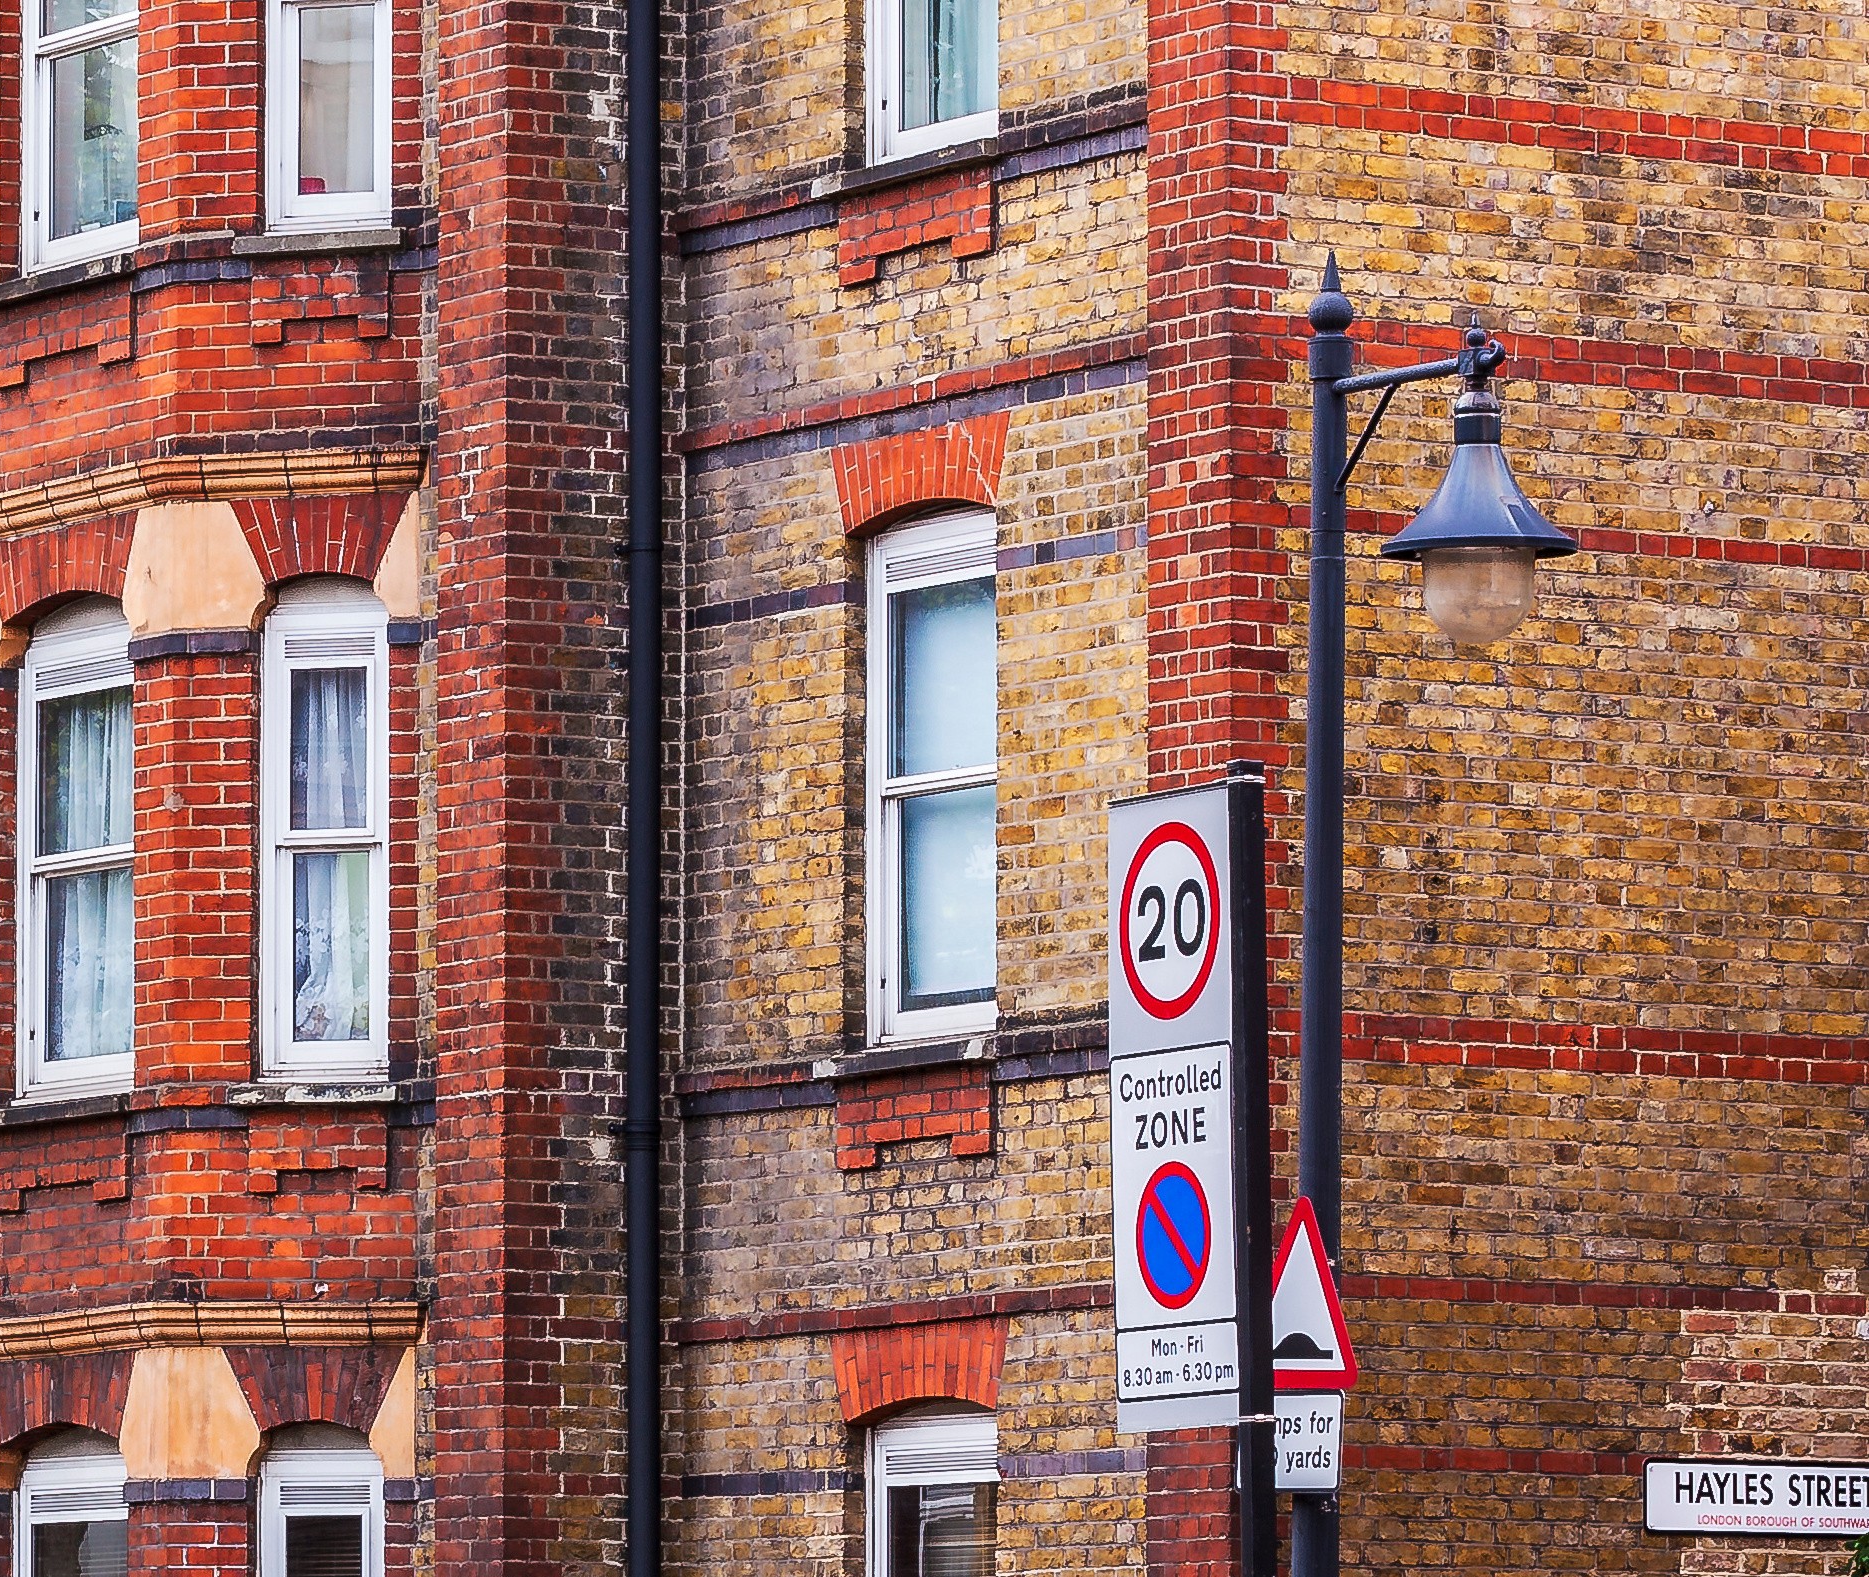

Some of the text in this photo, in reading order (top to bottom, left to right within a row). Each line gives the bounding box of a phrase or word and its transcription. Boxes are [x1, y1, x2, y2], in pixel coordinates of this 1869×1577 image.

[1138, 879, 1205, 962] 20
[1120, 1061, 1221, 1102] Controlled
[1135, 1107, 1206, 1150] ZONE
[1123, 1367, 1152, 1387] 8.30
[1155, 1370, 1173, 1384] am
[1183, 1362, 1212, 1382] 6.30
[1215, 1364, 1234, 1383] pm
[1310, 1411, 1333, 1434] for
[1286, 1445, 1331, 1473] yards
[1675, 1471, 1774, 1505] HAYLES
[1697, 1515, 1742, 1526] LONDON
[1746, 1515, 1797, 1527] BOROUGH
[1801, 1517, 1815, 1527] OF
